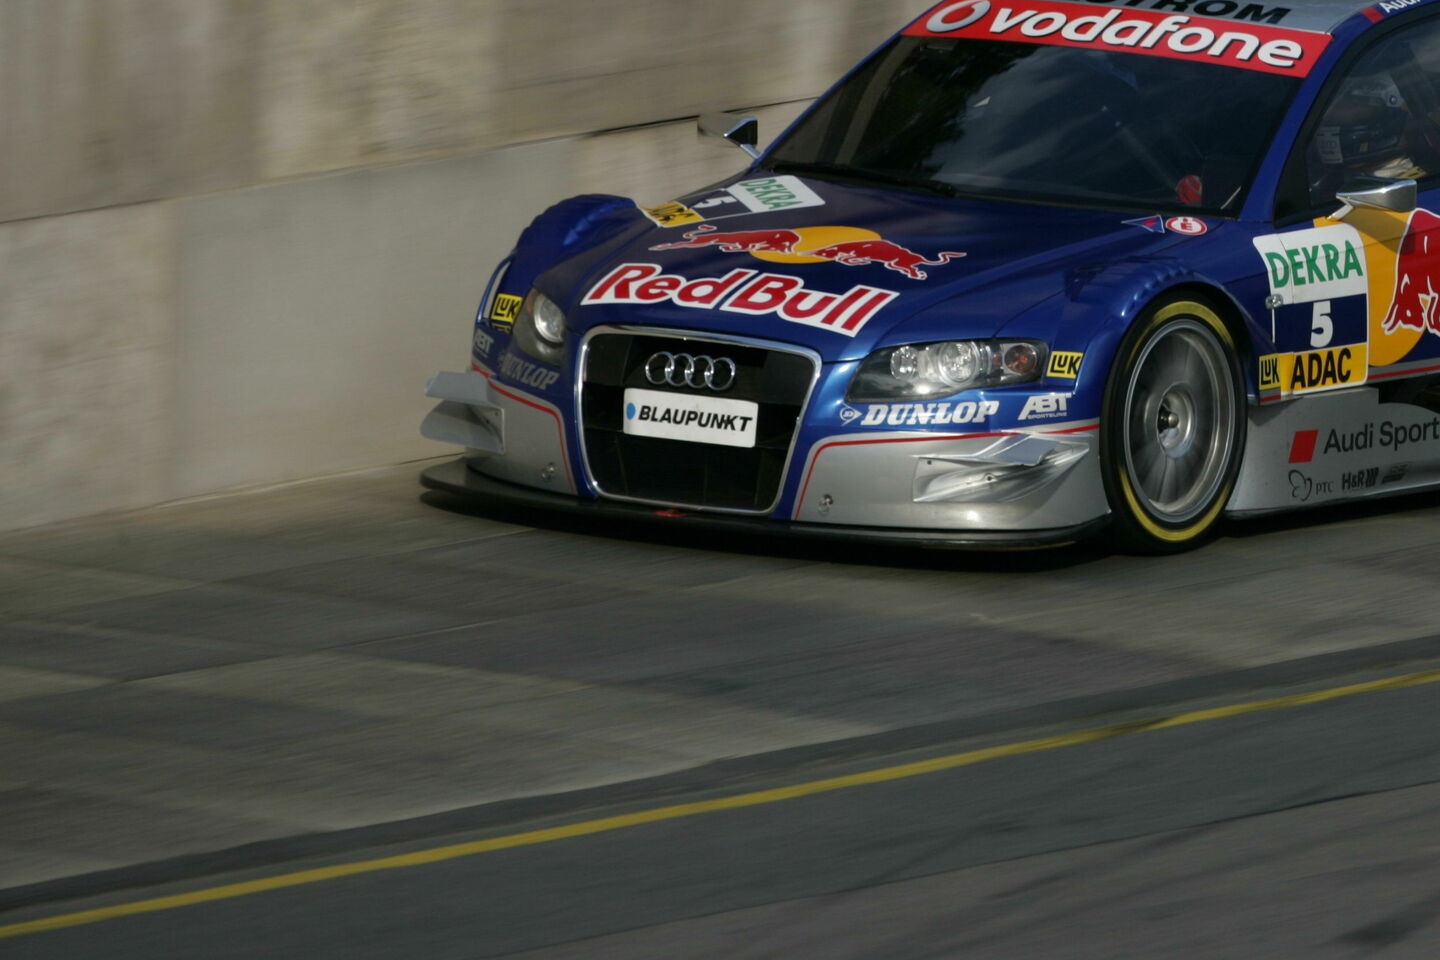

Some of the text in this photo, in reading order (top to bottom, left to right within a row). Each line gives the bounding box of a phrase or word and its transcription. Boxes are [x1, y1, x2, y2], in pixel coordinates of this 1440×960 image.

[989, 6, 1303, 68] vodafone
[691, 195, 738, 209] 5
[738, 178, 803, 210] DEKRA
[1266, 240, 1364, 289] DEKRA
[584, 263, 894, 334] Red Bull
[1310, 300, 1334, 348] 5
[1290, 347, 1352, 390] ADAC
[638, 405, 753, 433] BLAUPUNKT
[860, 400, 1000, 426] DUNLOP
[1017, 392, 1073, 421] ABT
[1323, 417, 1440, 454] Audi Sport
